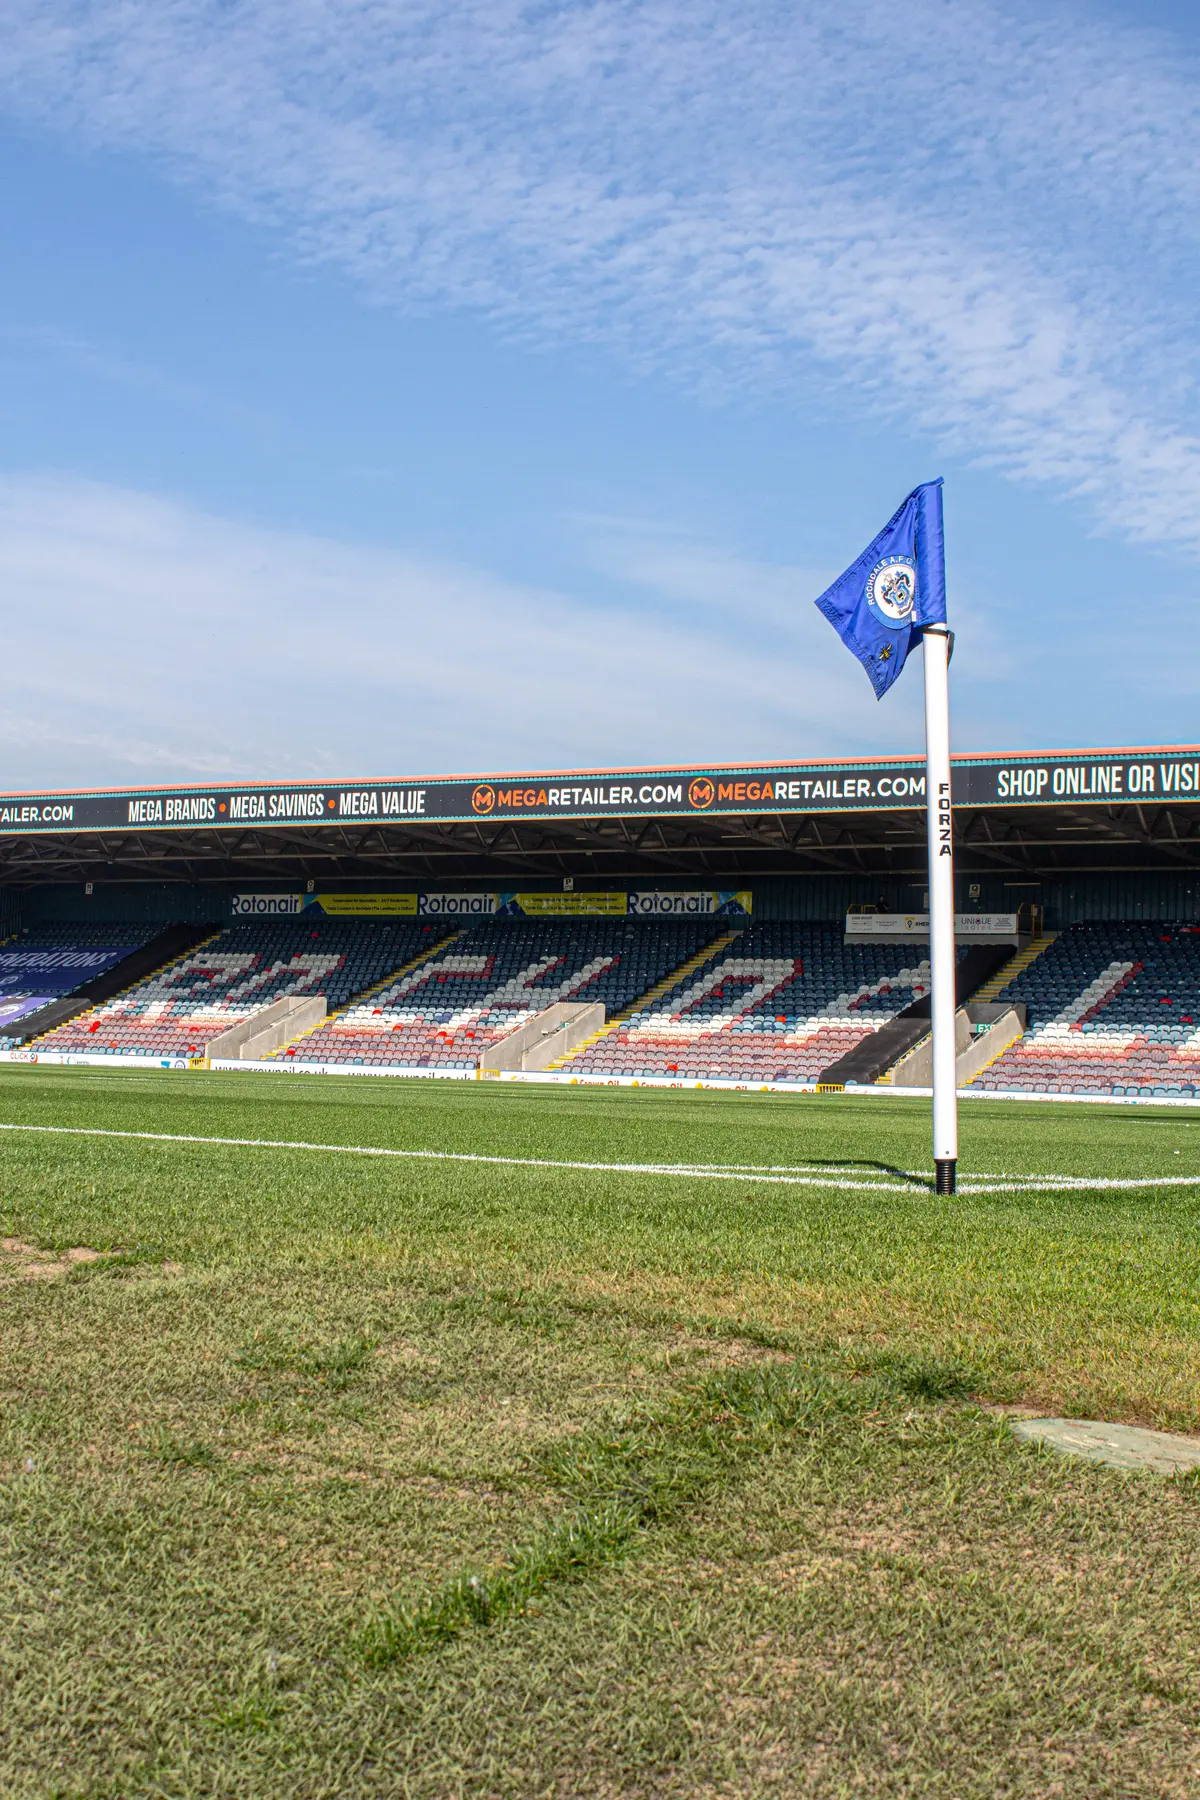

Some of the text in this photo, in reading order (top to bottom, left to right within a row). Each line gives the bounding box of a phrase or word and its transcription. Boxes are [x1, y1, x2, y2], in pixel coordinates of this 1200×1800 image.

[866, 559, 888, 606] ROCHDALE
[718, 776, 926, 802] MEGARETAILER.COM
[997, 769, 1049, 797] SHOP
[1053, 765, 1124, 795] ONLINE
[1128, 764, 1155, 793] OR
[128, 790, 426, 822] MEGA BRANDS MEGA SAVINGS MEGA VALUE
[497, 785, 683, 807] MEGARETAILER.COM
[938, 783, 952, 857] FORZA
[231, 894, 299, 914] Rotonair
[418, 894, 494, 914] Rotonair
[628, 892, 713, 914] Rotonair
[0, 952, 117, 968] ENERATIONS
